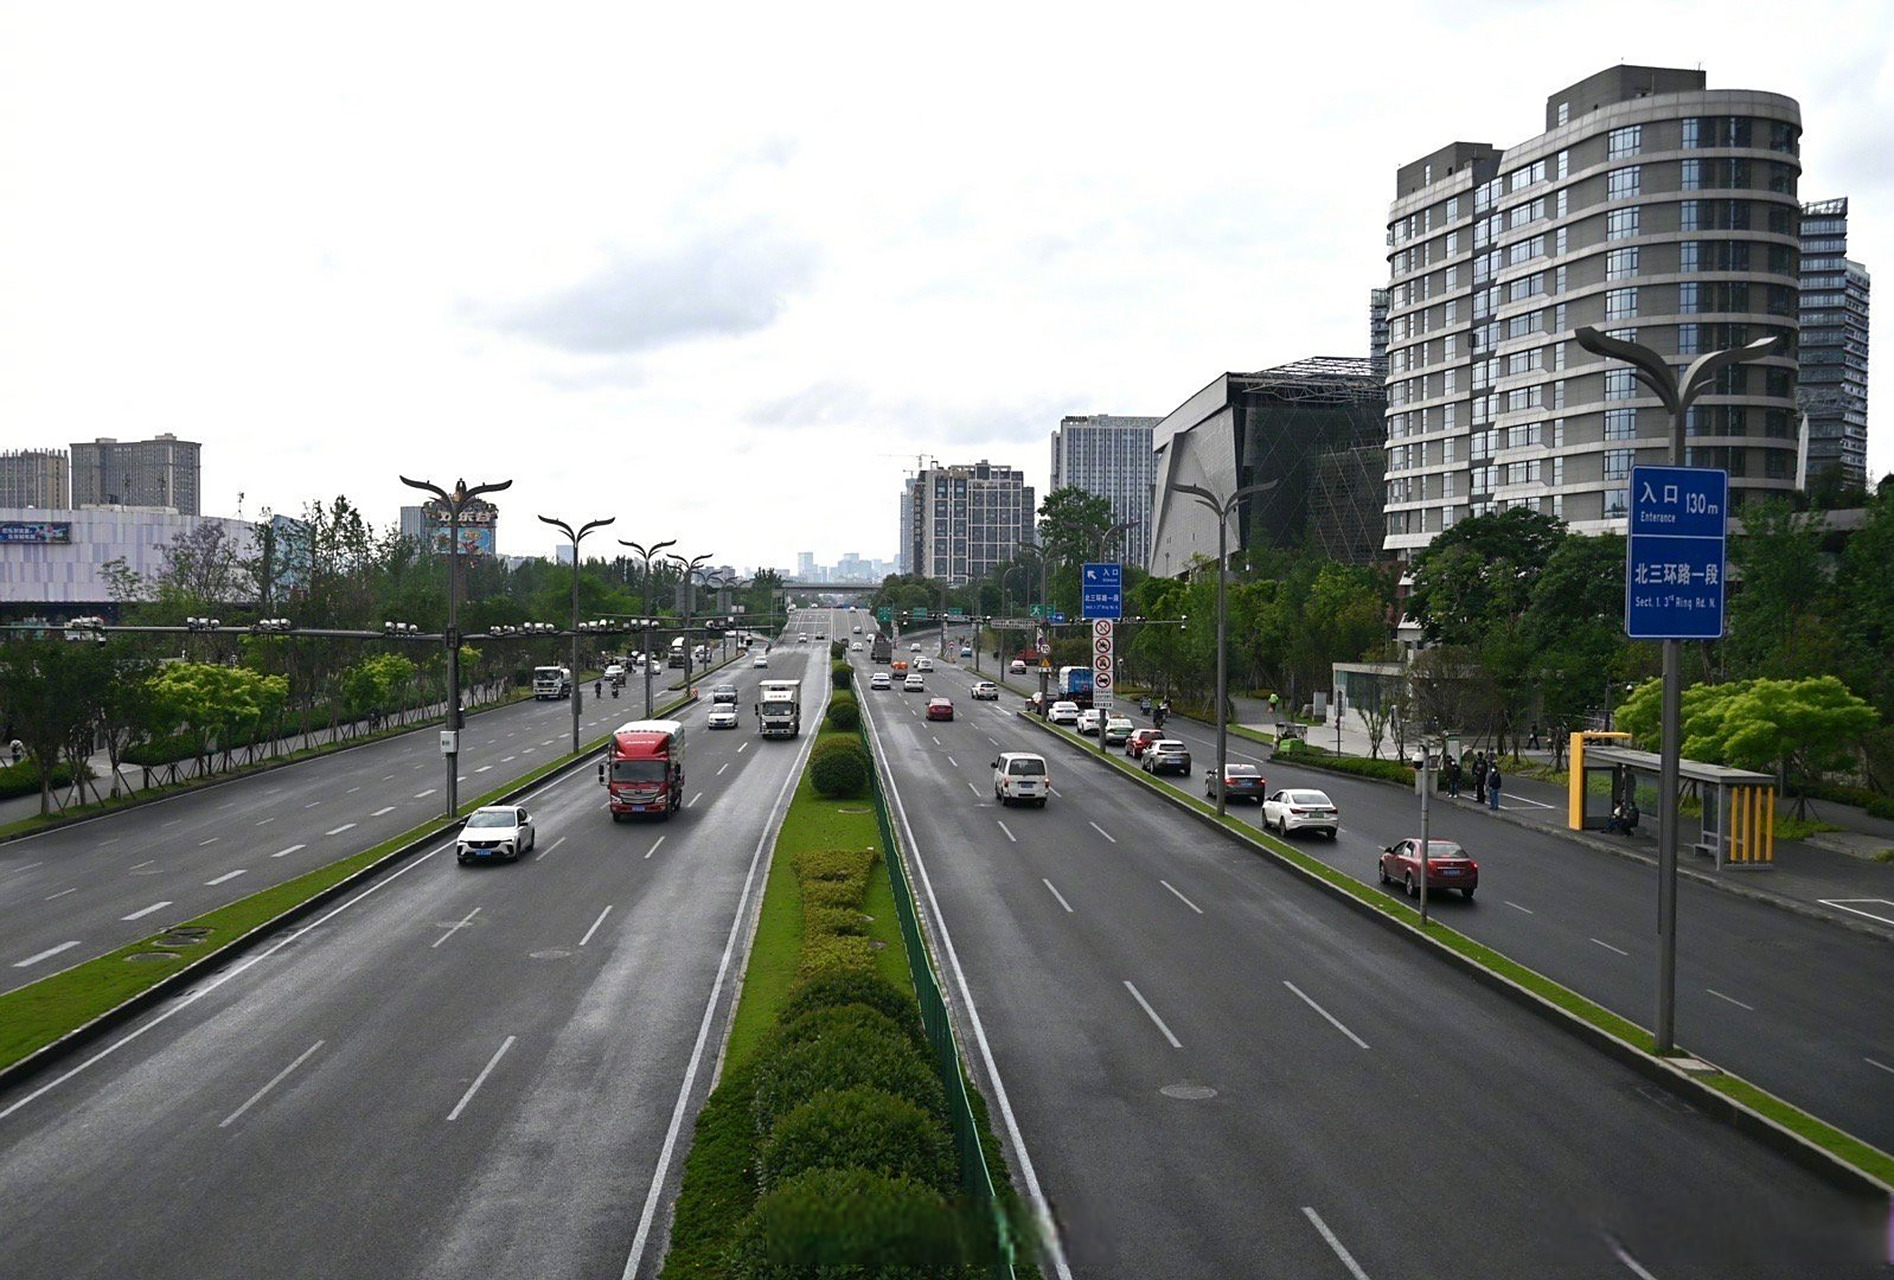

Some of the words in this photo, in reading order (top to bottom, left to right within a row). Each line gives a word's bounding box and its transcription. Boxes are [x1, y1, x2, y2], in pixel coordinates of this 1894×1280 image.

[1640, 482, 1678, 504] 入口
[1640, 511, 1676, 523] Enterance
[1103, 568, 1118, 576] 入口
[1635, 562, 1719, 585] 北三环路一段
[1675, 597, 1692, 611] Ring
